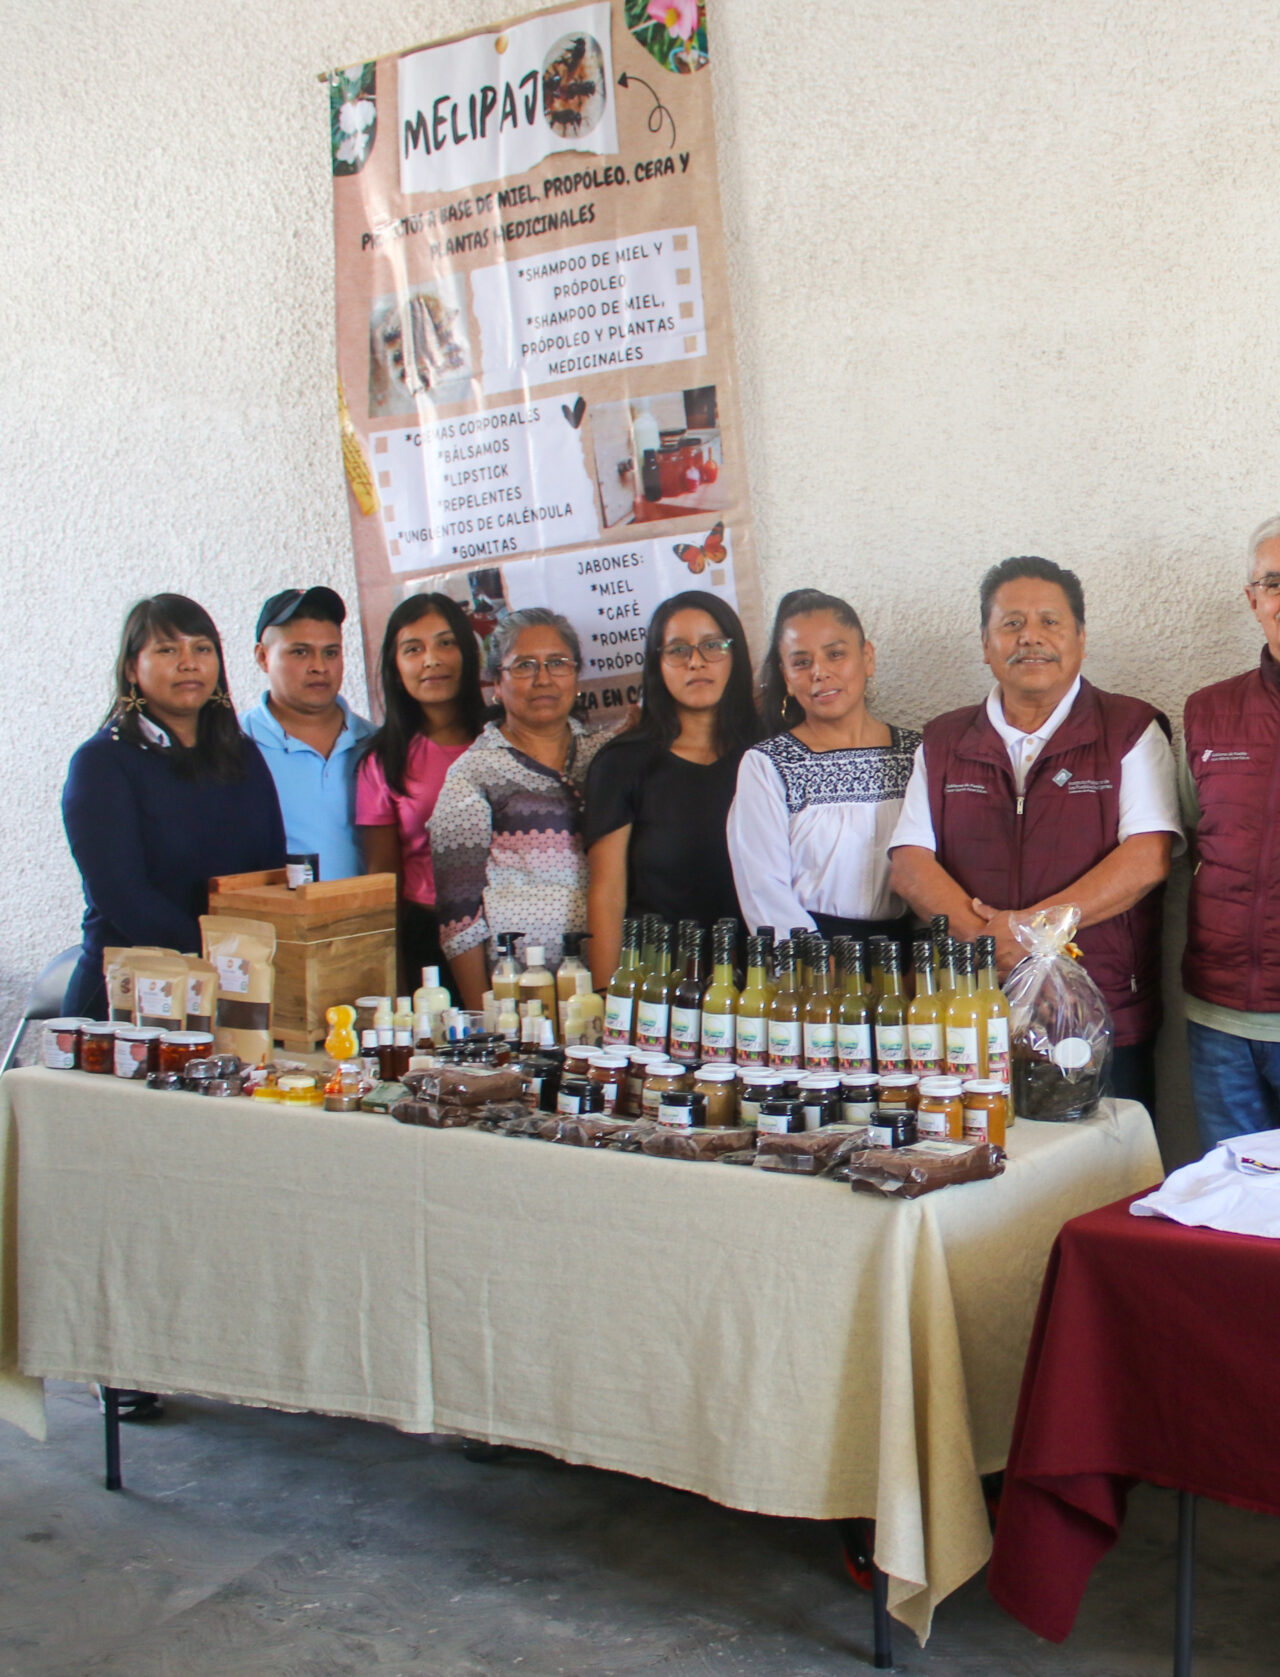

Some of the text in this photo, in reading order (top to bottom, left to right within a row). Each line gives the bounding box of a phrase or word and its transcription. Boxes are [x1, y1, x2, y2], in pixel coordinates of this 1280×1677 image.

[404, 69, 539, 161] MELIPAJ
[428, 210, 437, 229] A
[440, 199, 473, 224] BASE
[476, 193, 495, 216] DE
[634, 156, 675, 183] CERA
[679, 151, 690, 173] Y
[430, 202, 596, 260] PLANTAS MEDICINALES
[591, 251, 610, 267] DE
[616, 244, 649, 263] MIEL
[654, 241, 664, 255] Y
[554, 274, 626, 300] PRÓPOLEO
[601, 299, 620, 316] DE
[521, 316, 676, 357] PRÓPOLEO Y PLANTAS
[549, 346, 644, 376] MEDICINALES
[405, 407, 541, 447] CEMAS CORPORALES
[478, 516, 493, 532] DE
[497, 502, 573, 528] CALÉNDULA
[578, 552, 645, 576] JABONES:
[591, 627, 648, 647] ROMER
[590, 651, 644, 672] PRÓPO
[602, 688, 623, 709] EN
